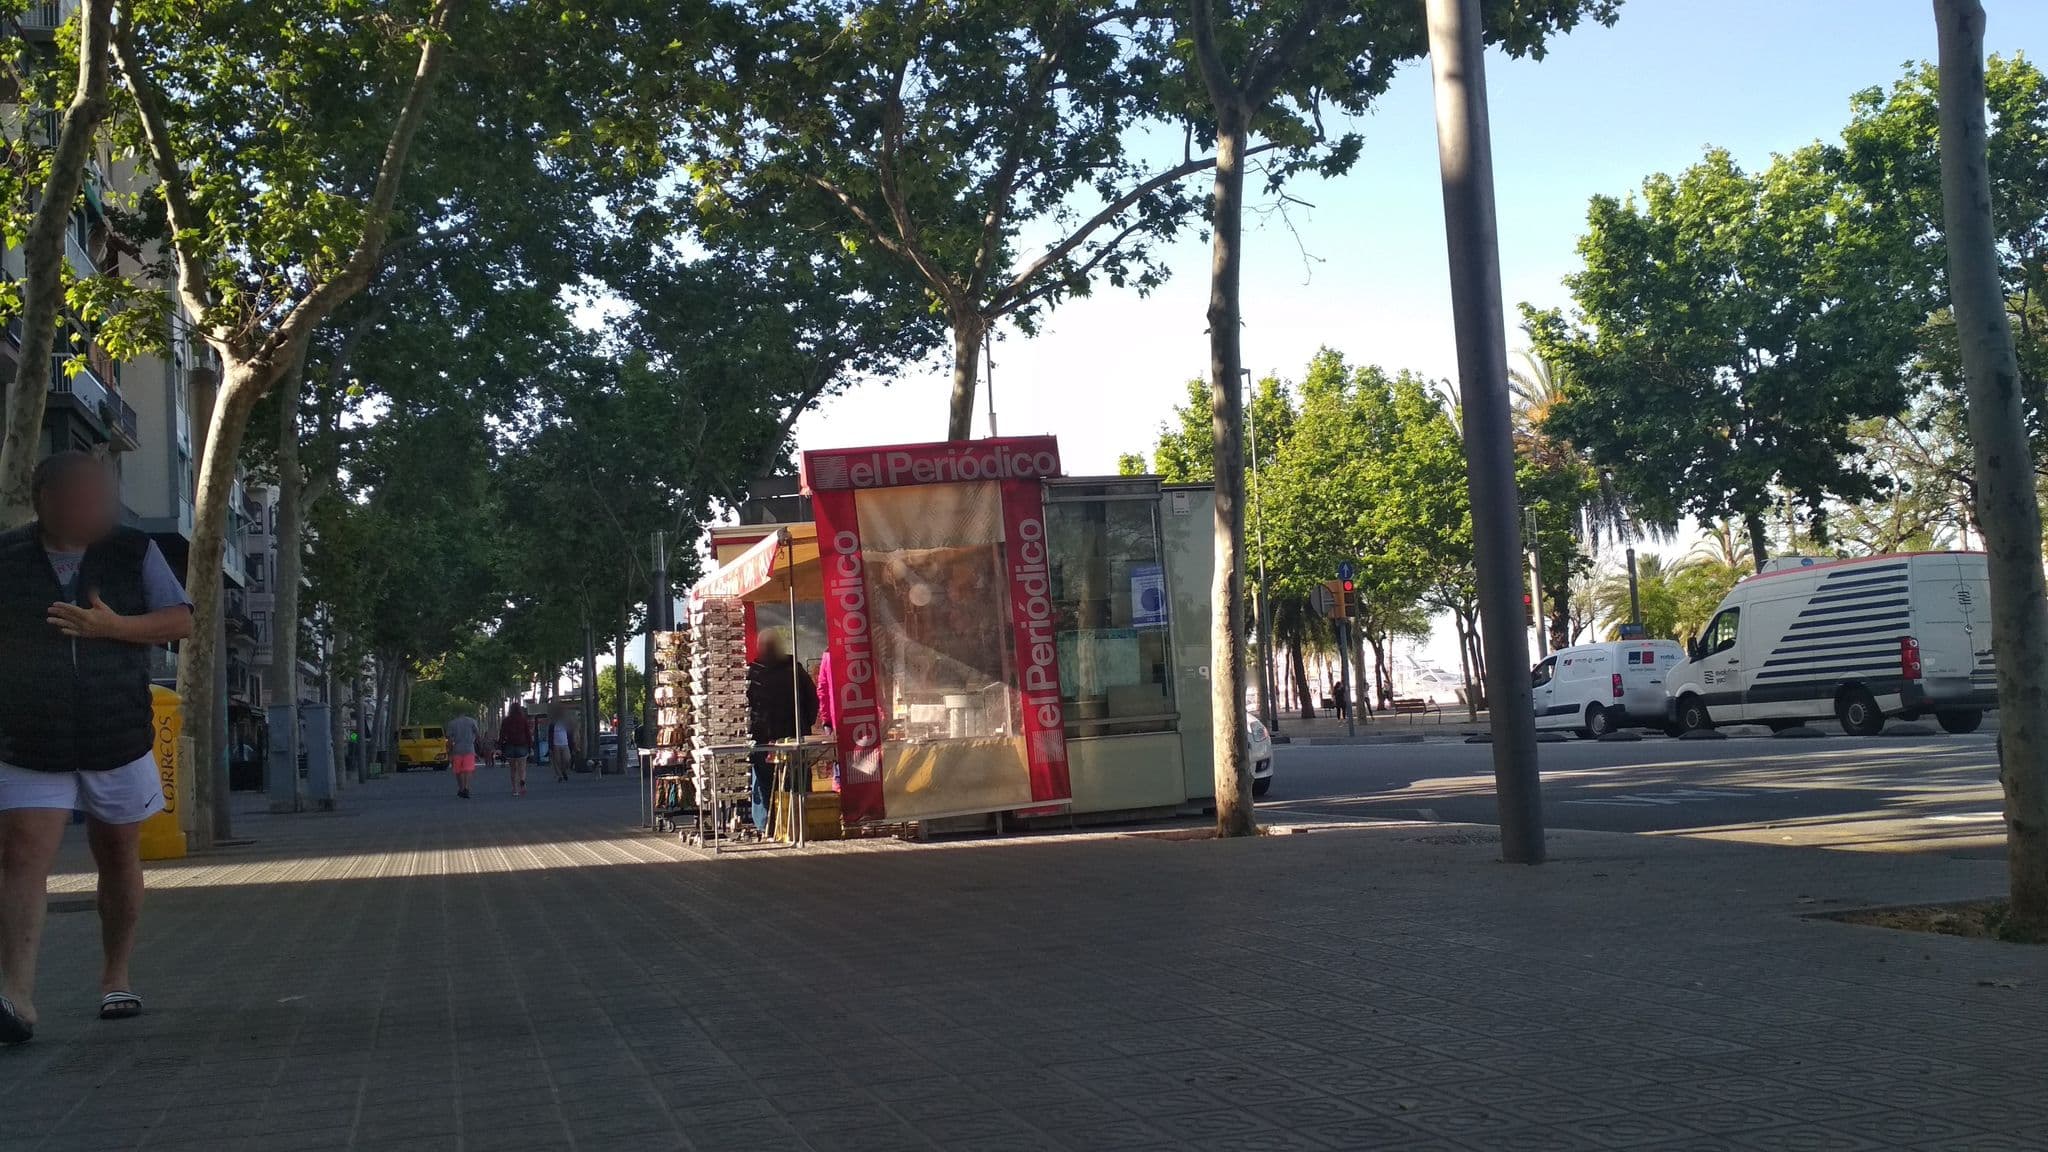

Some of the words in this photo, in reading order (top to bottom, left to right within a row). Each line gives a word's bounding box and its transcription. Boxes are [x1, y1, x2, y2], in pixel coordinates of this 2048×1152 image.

[886, 445, 1057, 486] Periódico
[831, 530, 874, 711] Periódico
[1016, 518, 1056, 692] Periódico
[158, 715, 175, 813] CORREOS
